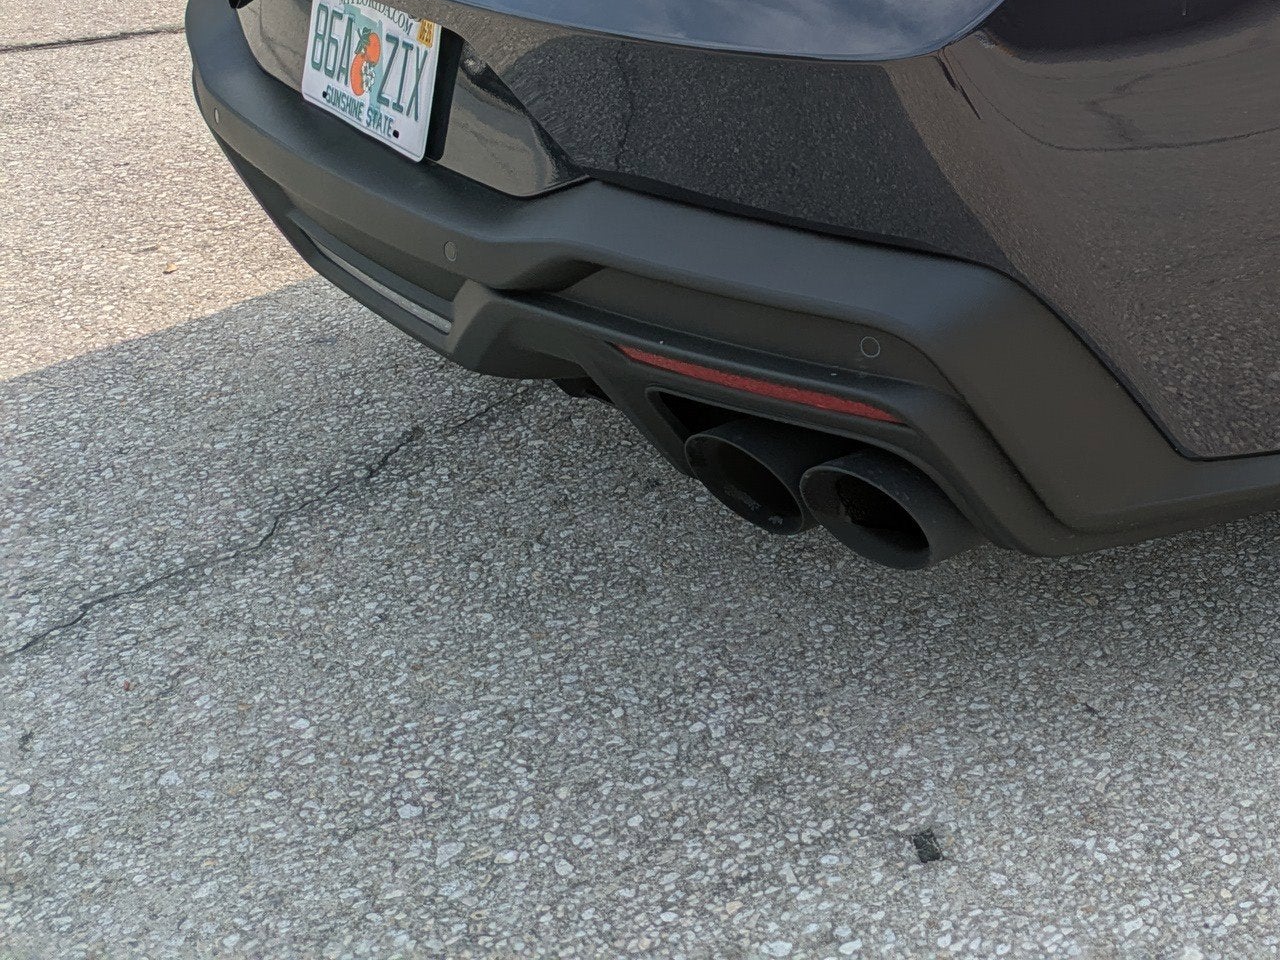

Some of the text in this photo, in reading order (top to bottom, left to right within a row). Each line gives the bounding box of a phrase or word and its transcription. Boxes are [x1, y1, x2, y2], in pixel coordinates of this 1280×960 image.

[311, 3, 428, 121] 86A ZIX
[325, 84, 395, 138] SUNSHINE STATE
